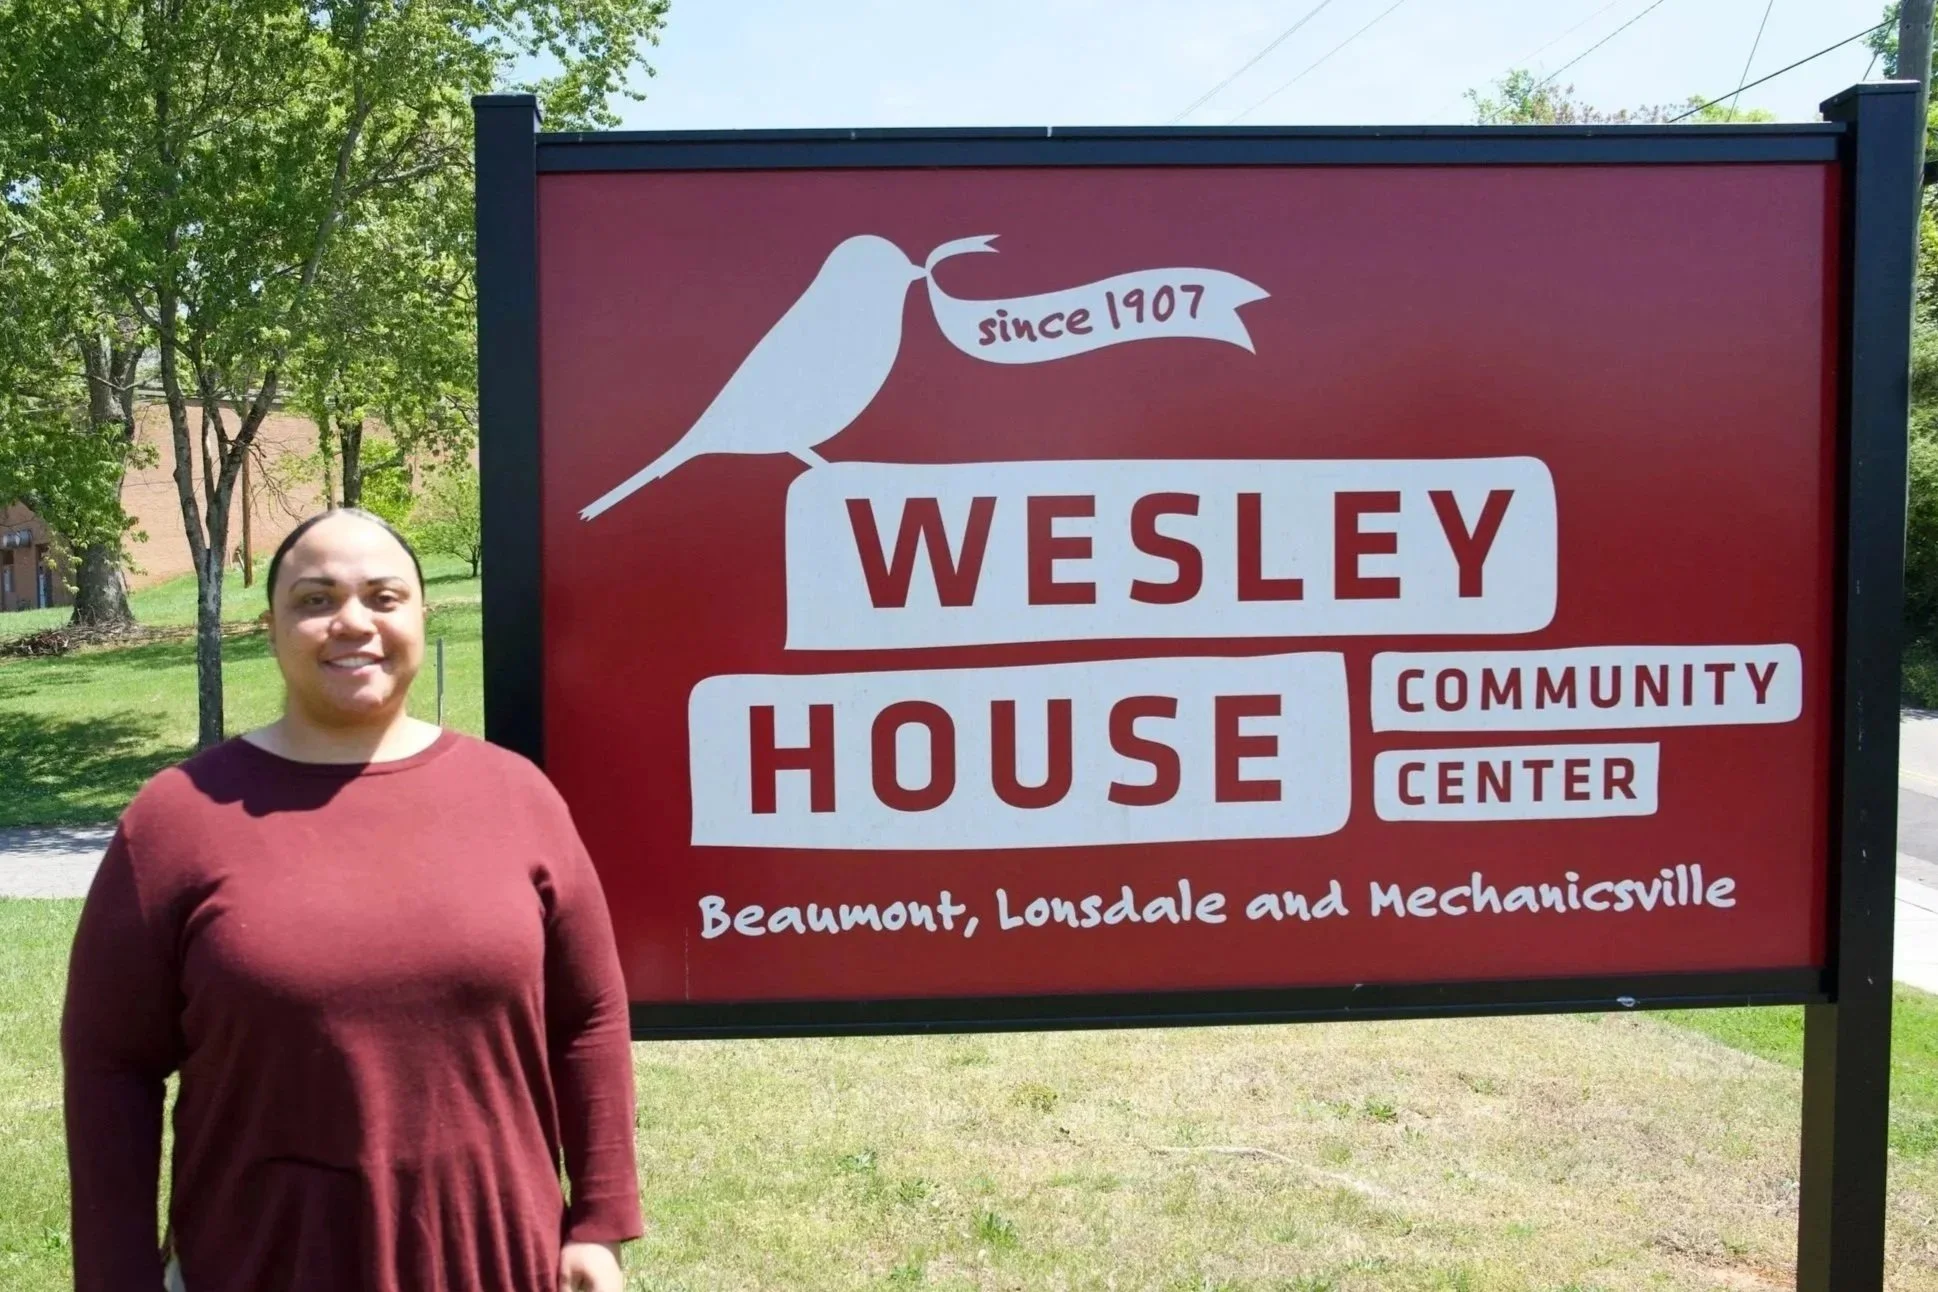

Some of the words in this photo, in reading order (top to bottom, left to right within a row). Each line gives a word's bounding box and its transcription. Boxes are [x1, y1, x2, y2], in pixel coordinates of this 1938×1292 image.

[978, 308, 1094, 346] since
[1105, 284, 1205, 330] 1907
[845, 489, 1515, 609] WESLEY
[1397, 661, 1779, 713] COMMUNITY
[750, 694, 1282, 815] HOUSE
[1398, 757, 1637, 806] CENTER
[699, 890, 979, 939] Beaumont,
[996, 878, 1227, 930] Lonsdale
[1245, 879, 1350, 921] and
[1369, 863, 1736, 918] Mechanicsville
